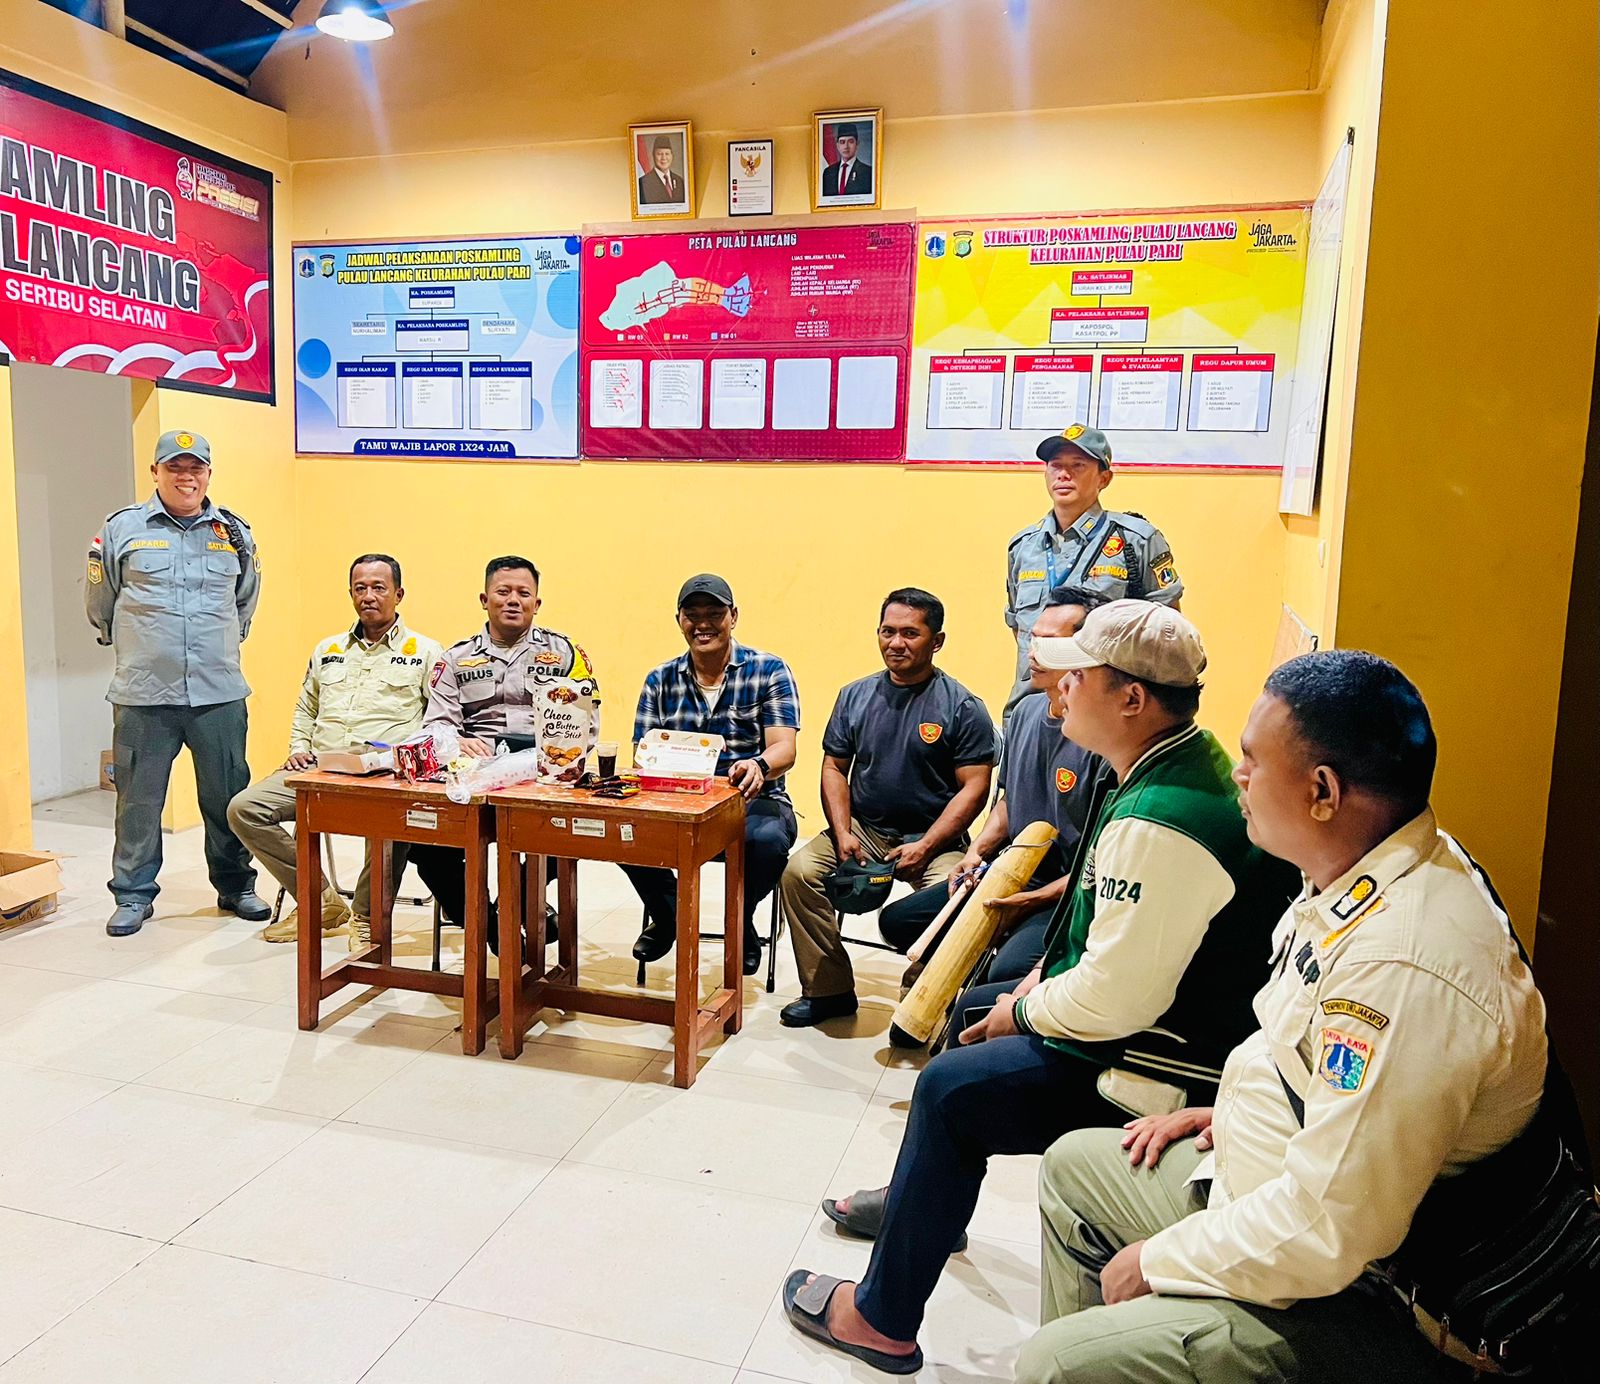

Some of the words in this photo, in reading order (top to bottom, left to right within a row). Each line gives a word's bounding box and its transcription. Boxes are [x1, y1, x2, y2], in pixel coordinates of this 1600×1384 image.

[0, 137, 176, 244] AMLING
[983, 229, 1048, 246] STRUKTUR
[1049, 226, 1132, 245] POSKAMLING
[1133, 224, 1176, 243] PULAU
[1177, 222, 1237, 241] LANCANG
[1248, 222, 1272, 236] JAGA
[689, 237, 713, 250] PETA
[716, 235, 747, 249] PULAU
[750, 234, 797, 248] LANCANG
[346, 252, 386, 267] JADWAL
[386, 250, 454, 266] PELAKSANAAN
[455, 248, 521, 264] POSKAMLING
[534, 249, 552, 261] JAGA
[1029, 246, 1104, 264] KELURAHAN
[1105, 244, 1146, 263] PULAU
[1148, 243, 1184, 261] PARI
[0, 212, 200, 313] LANCANG
[337, 269, 369, 284] PULAU
[369, 268, 414, 284] LANCANG
[415, 267, 472, 282] KELURAHAN
[473, 265, 506, 281] PULAU
[506, 265, 531, 280] PARI
[5, 279, 85, 313] SERIBU
[88, 299, 167, 330] SELATAN
[360, 441, 388, 450] TAMU
[390, 442, 421, 451] WAJIB
[423, 442, 456, 451] LAPOR
[460, 442, 484, 452] 1X24
[487, 443, 509, 453] JAM
[390, 657, 407, 665] POL
[410, 658, 423, 666] PP
[457, 669, 494, 684] TULUS
[527, 666, 565, 677] POLRI
[543, 708, 572, 721] Choco
[555, 721, 580, 730] Butter
[564, 730, 582, 739] Stick
[1100, 876, 1142, 904] 2024
[1347, 1038, 1367, 1052] RAYA
